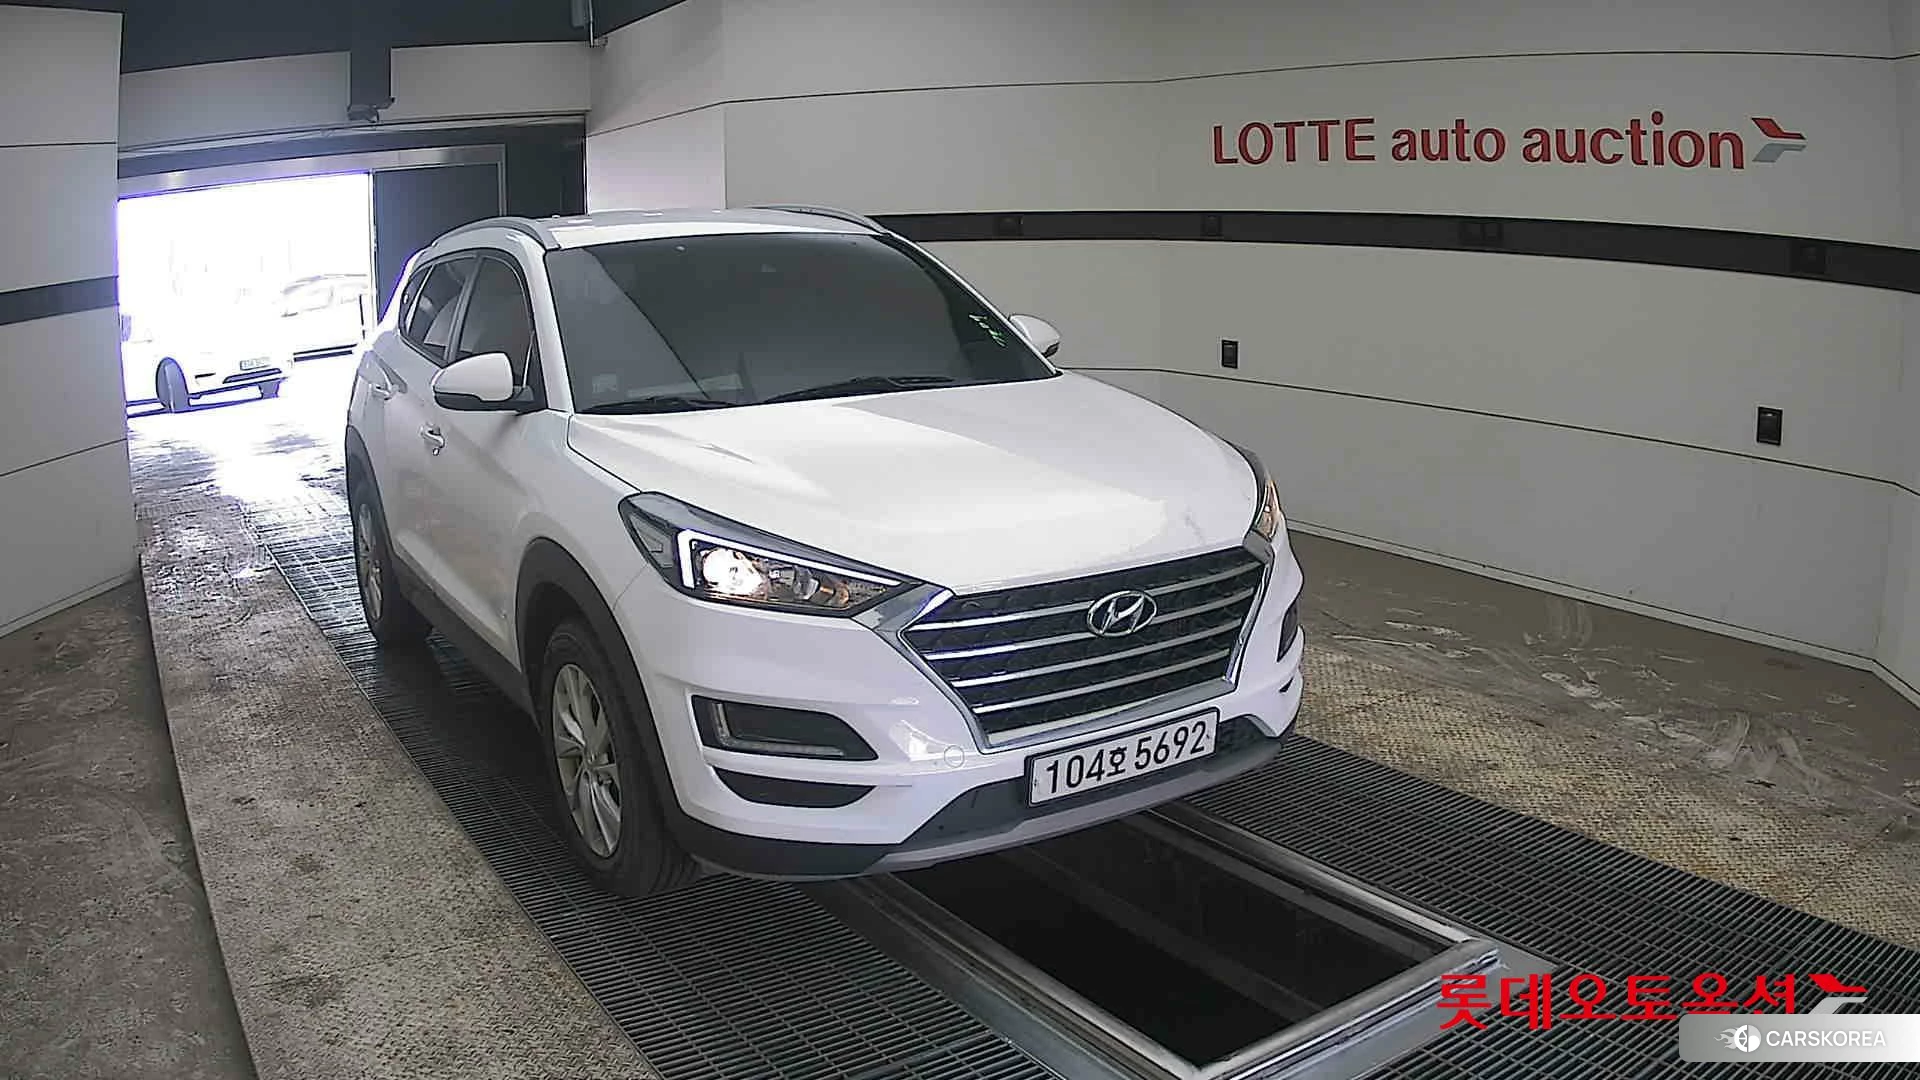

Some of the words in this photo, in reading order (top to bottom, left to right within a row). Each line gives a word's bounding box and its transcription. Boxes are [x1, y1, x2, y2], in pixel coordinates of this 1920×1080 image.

[1213, 117, 1376, 164] LOTTE
[1391, 118, 1506, 163] auto
[1522, 111, 1744, 169] auction
[1046, 746, 1127, 793] 104호
[1135, 721, 1206, 770] 5692
